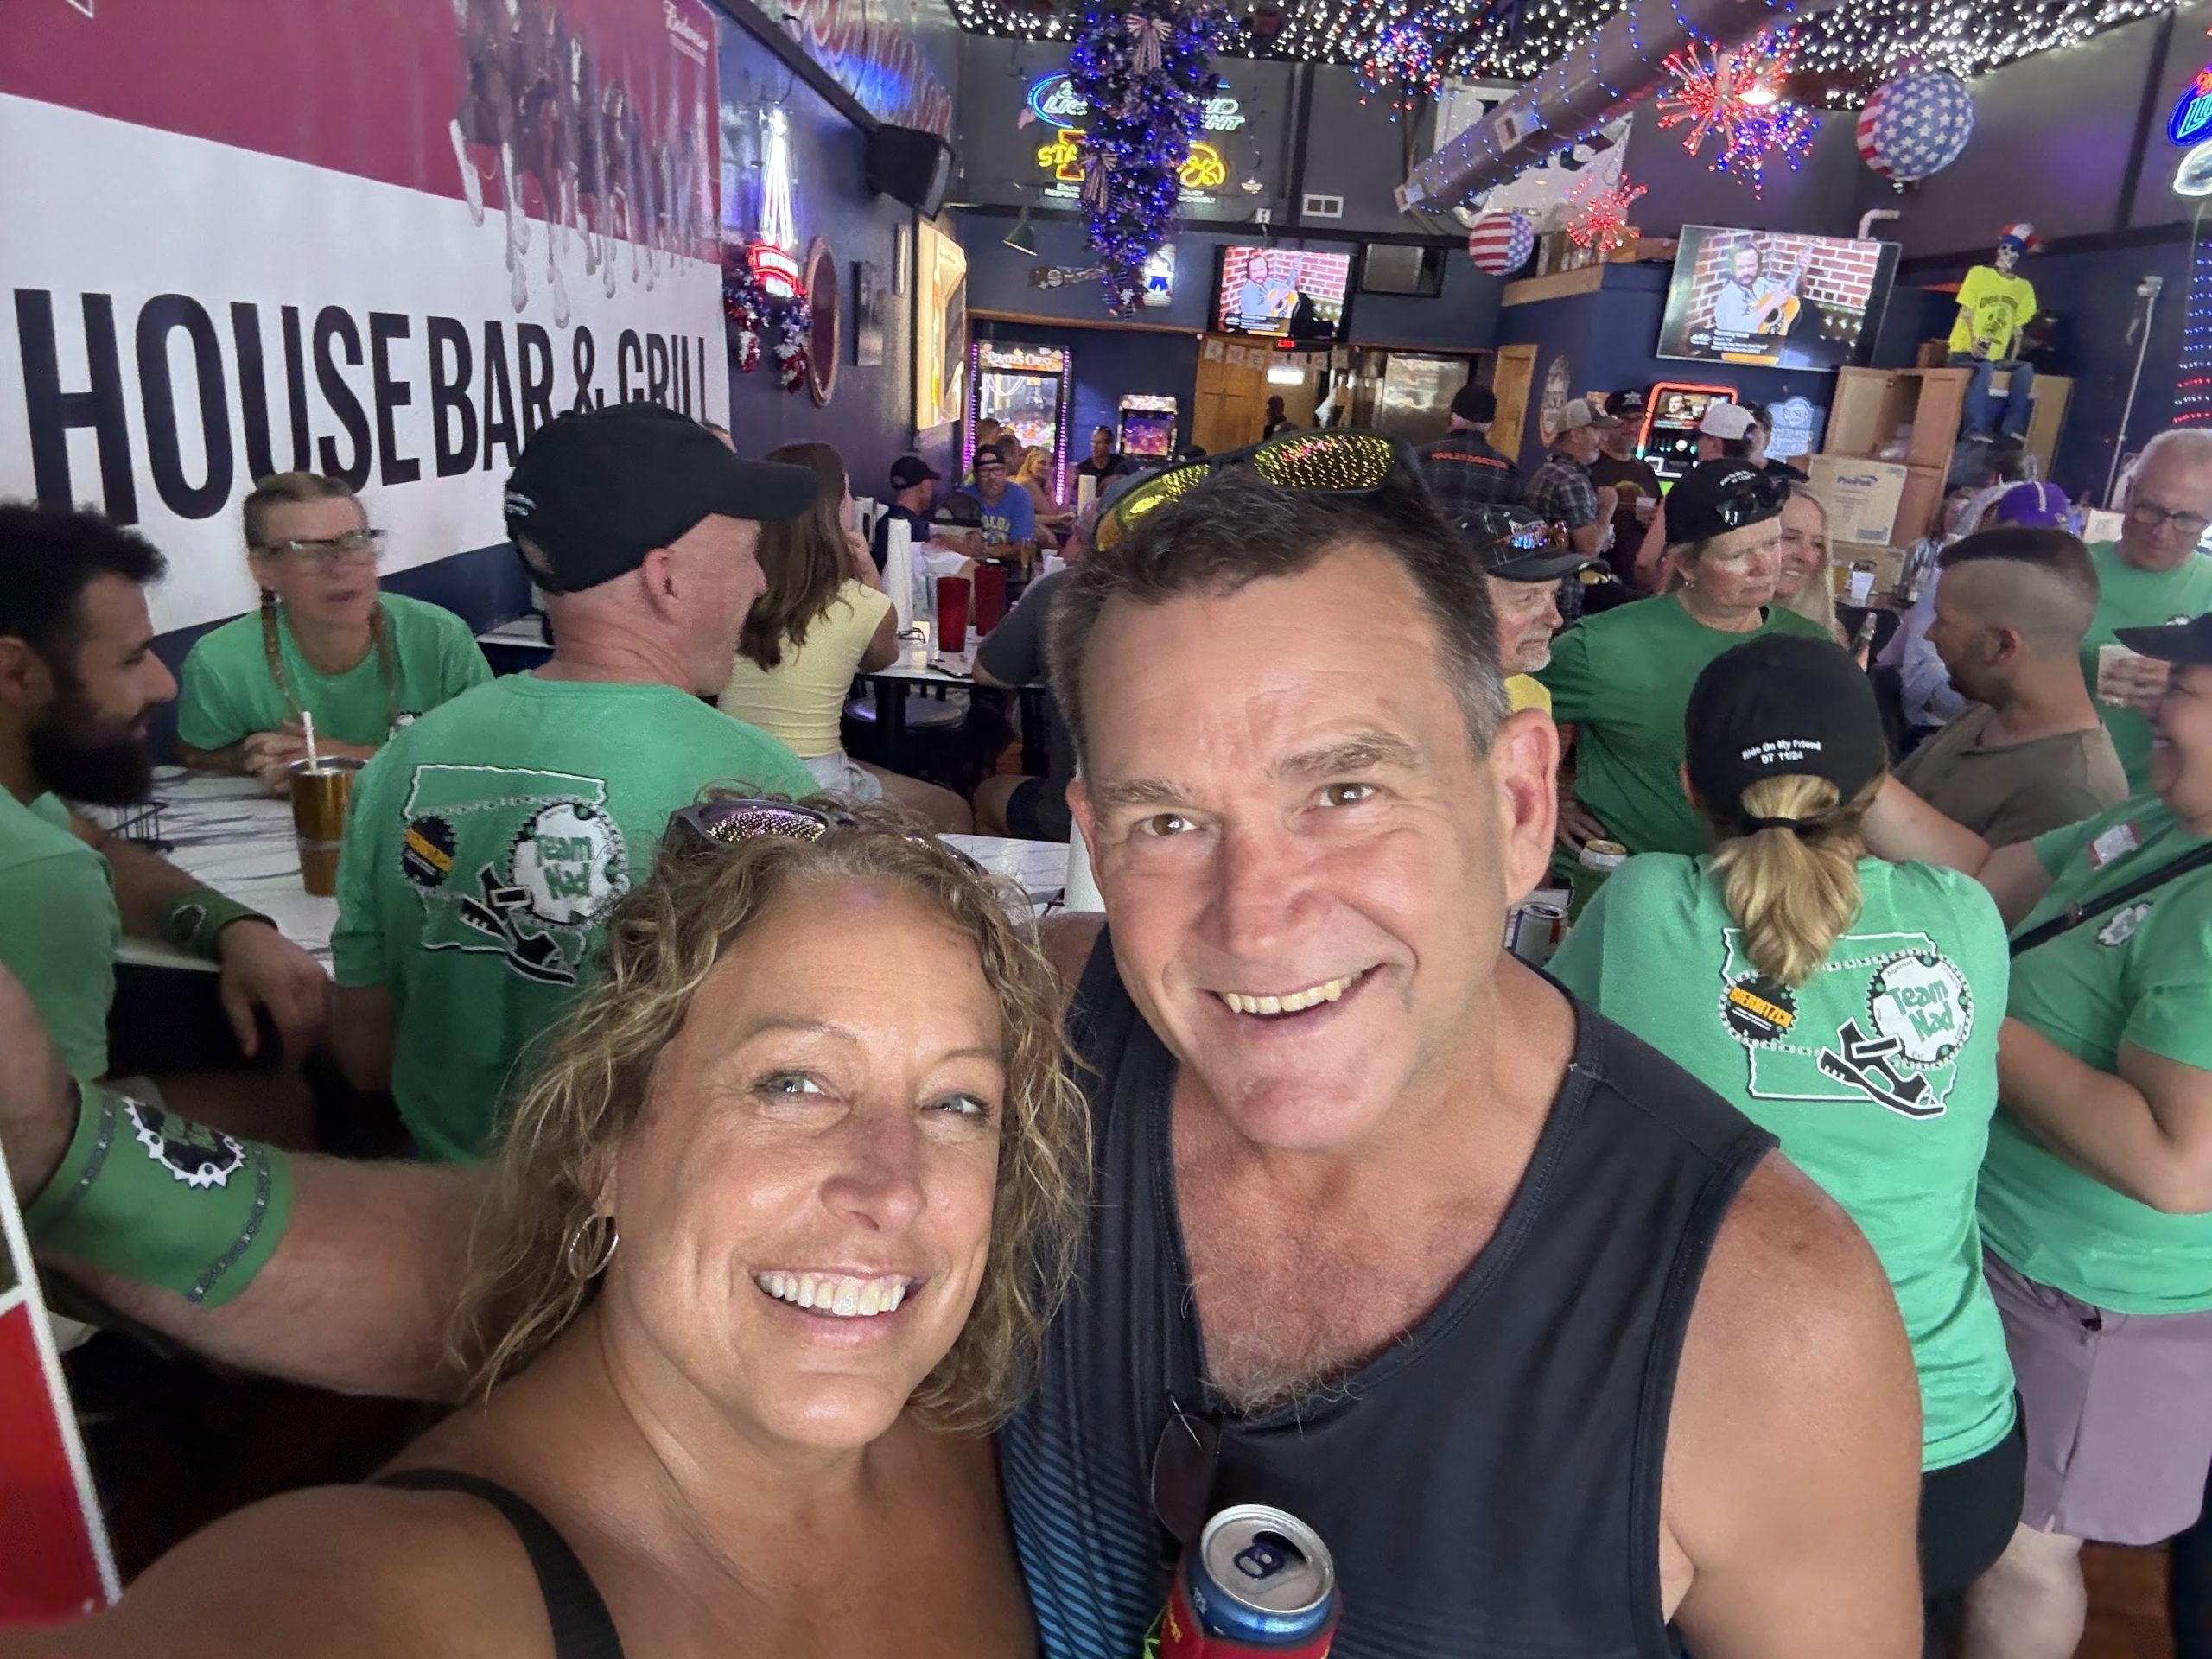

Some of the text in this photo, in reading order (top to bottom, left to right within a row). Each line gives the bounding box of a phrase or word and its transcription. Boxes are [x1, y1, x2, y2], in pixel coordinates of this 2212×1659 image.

[14, 288, 421, 525] HOUSE
[427, 315, 554, 478] BAR
[1741, 739, 1821, 761] Ride On My Friend
[1760, 753, 1775, 765] DT
[1885, 980, 1949, 1016] Team
[1908, 1000, 1955, 1044] Nad
